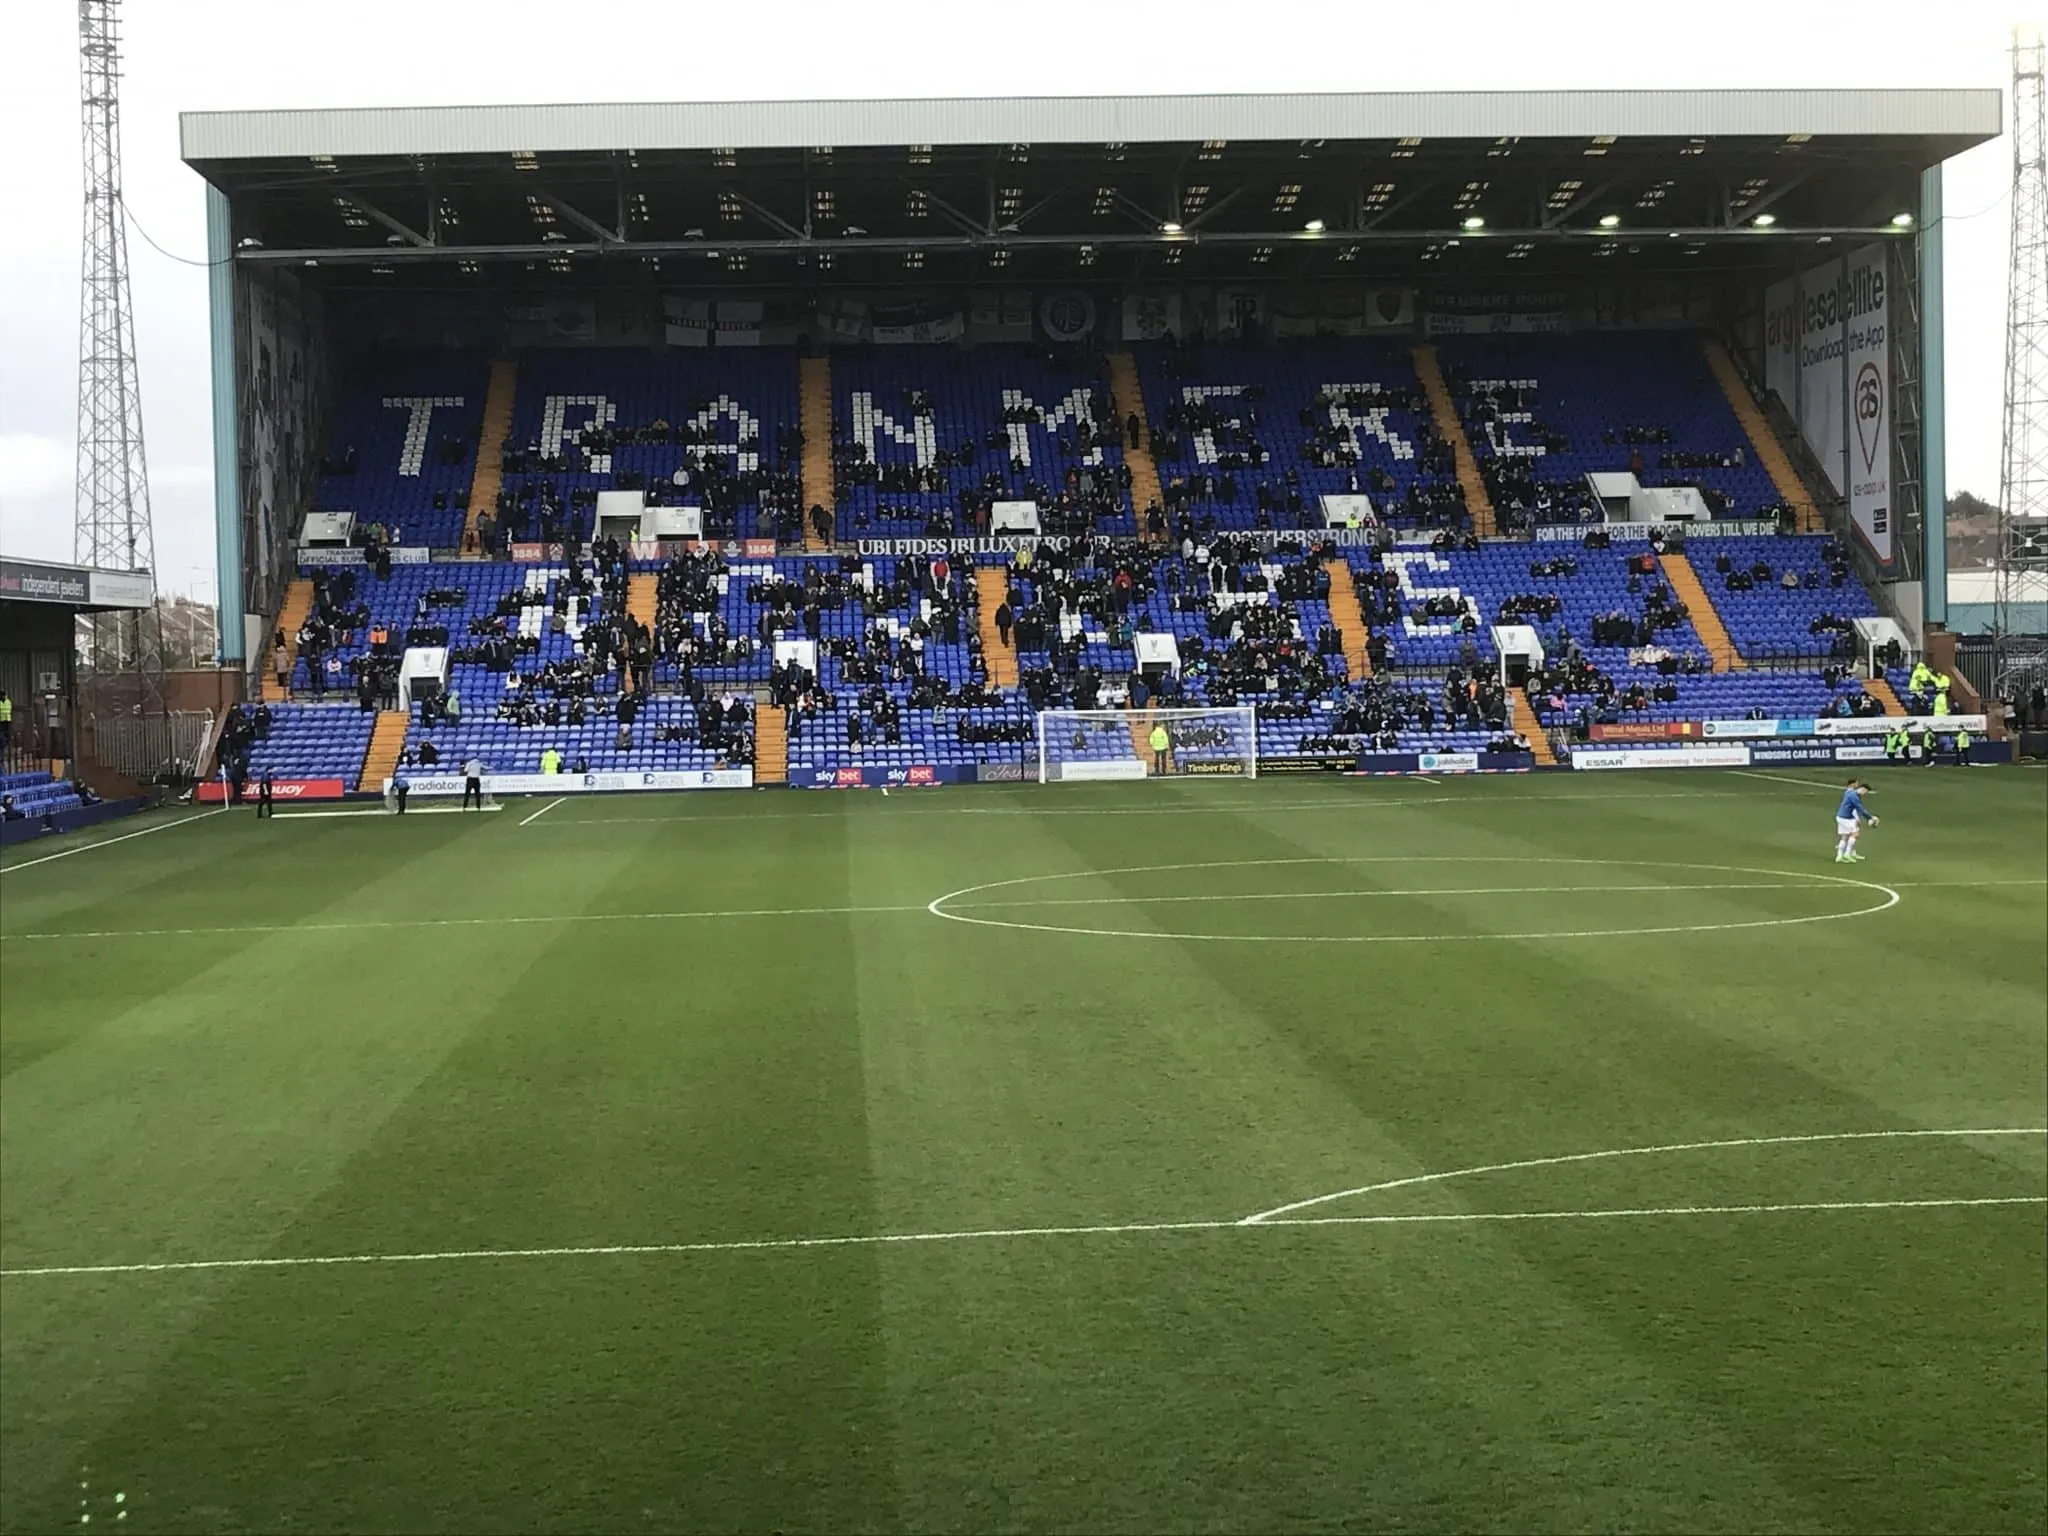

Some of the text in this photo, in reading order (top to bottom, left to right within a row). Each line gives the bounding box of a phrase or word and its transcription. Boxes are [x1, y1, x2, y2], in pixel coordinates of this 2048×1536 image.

[1866, 325, 1885, 351] App
[1536, 527, 1555, 541] FOR
[1557, 526, 1575, 541] THE
[1606, 525, 1626, 540] FOR
[1627, 523, 1647, 539] THE
[1685, 521, 1775, 537] ROVERS TILL WE DIE
[1308, 528, 1397, 547] STRONGR
[747, 544, 776, 555] 1884
[858, 539, 891, 556] UBI
[979, 536, 1017, 554] LUX
[402, 554, 428, 564] CLUB
[1652, 724, 1665, 733] Ltd
[1692, 756, 1704, 764] for
[1793, 750, 1808, 760] CAR
[1809, 749, 1831, 759] SALES
[1187, 762, 1242, 774] Timber Kings
[1586, 759, 1623, 767] ESSAR
[816, 769, 859, 783] sky bet
[888, 767, 932, 782] sky bet
